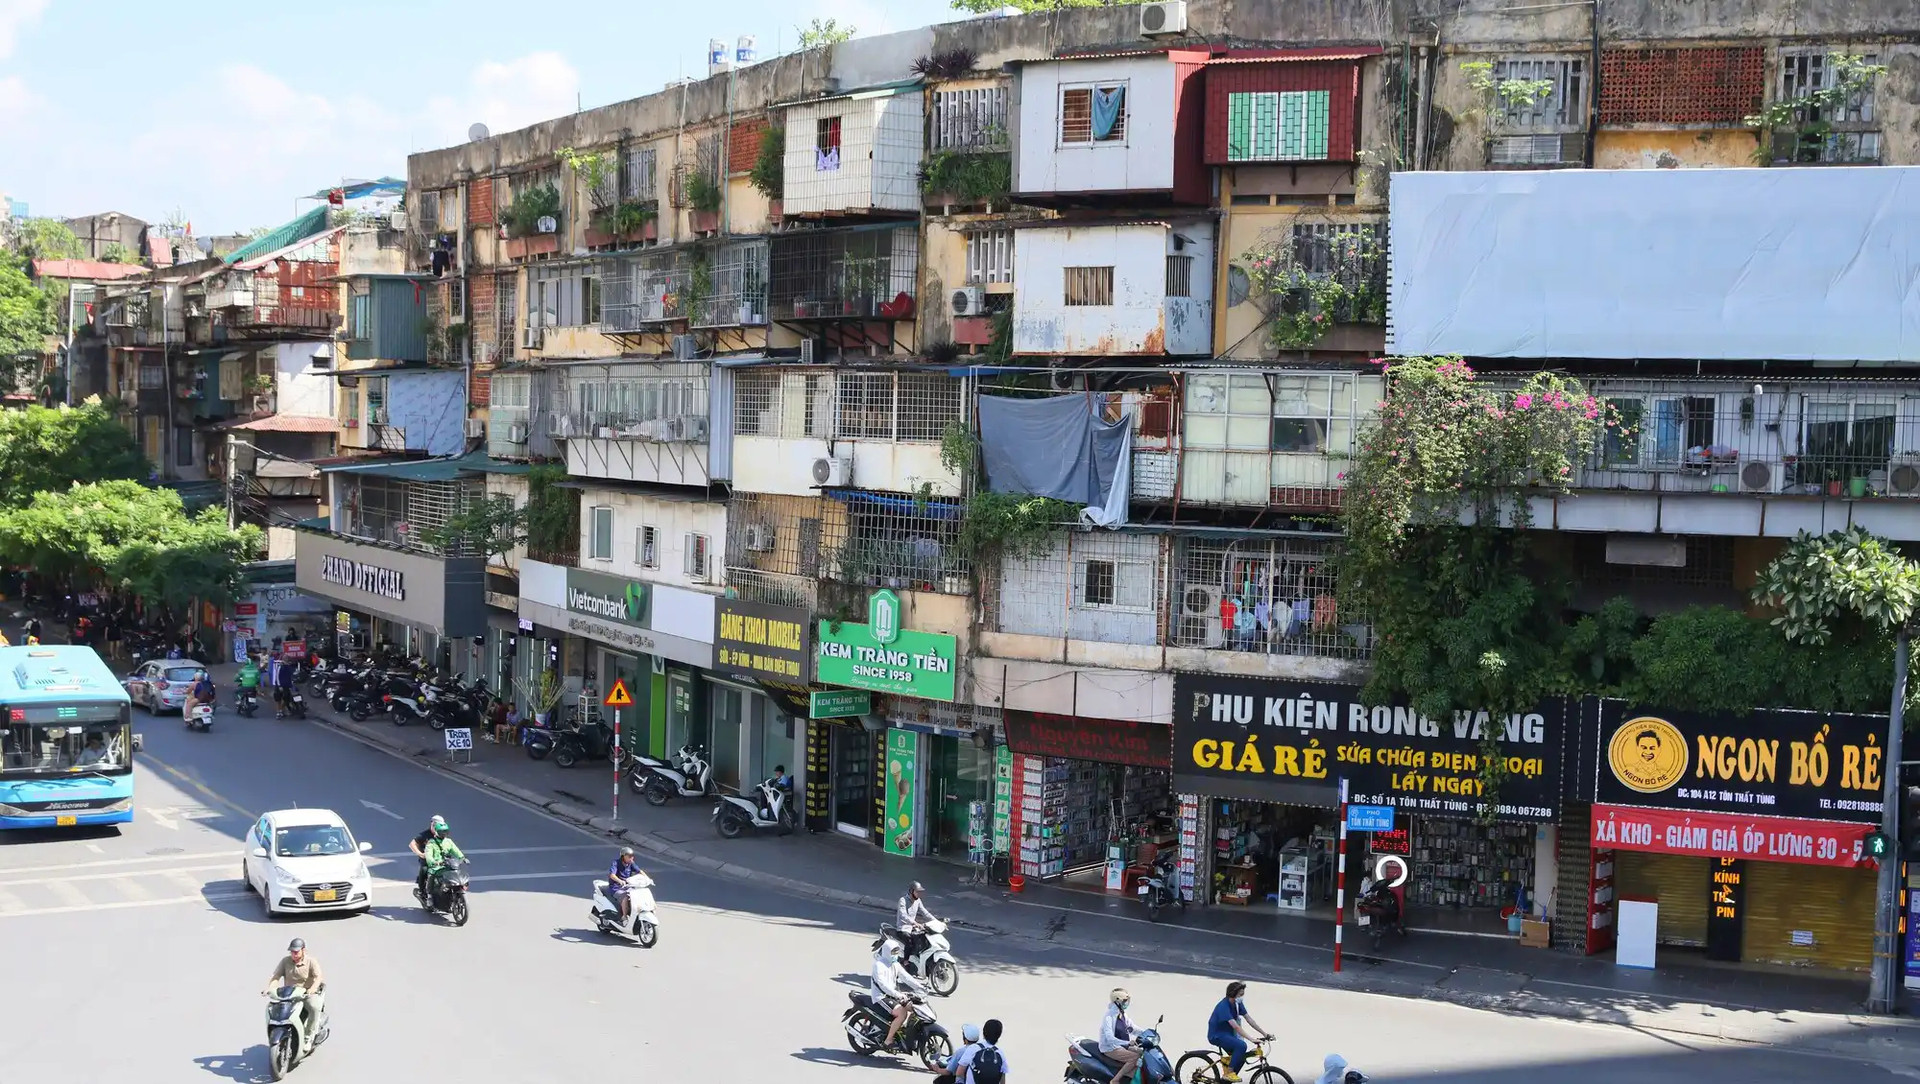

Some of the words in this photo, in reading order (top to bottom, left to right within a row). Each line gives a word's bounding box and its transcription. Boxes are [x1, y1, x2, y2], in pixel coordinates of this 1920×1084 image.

[322, 554, 353, 586] 2HAND
[355, 562, 404, 601] OFFICIAL
[569, 588, 626, 620] Vietcombank
[744, 616, 767, 645] KHOA
[768, 620, 800, 650] MOBILE
[820, 641, 852, 659] KEM
[856, 644, 908, 667] TRÀNG
[913, 647, 949, 673] TIỀN
[853, 665, 886, 678] SINCE
[890, 670, 912, 682] 1958
[817, 698, 830, 706] KEM
[1264, 692, 1338, 735] KIỆN
[448, 739, 461, 748] XE
[462, 739, 470, 747] 10
[1192, 734, 1266, 773] GIÁ
[1272, 738, 1327, 779] RẺ
[1337, 741, 1372, 765] SỬA
[1376, 746, 1425, 768] CHỮA
[1696, 735, 1779, 783] NGON
[1789, 724, 1830, 787] BỔ
[1840, 732, 1881, 790] RẺ
[1392, 770, 1428, 792] LẤY
[1433, 776, 1484, 797] NGAY
[1623, 769, 1644, 784] NGON
[1371, 793, 1384, 804] SỐ
[1386, 797, 1396, 805] 1A
[1399, 796, 1416, 807] TÔN
[1420, 797, 1441, 809] THẤT
[1444, 799, 1468, 811] TÙNG
[1518, 807, 1552, 817] 067286
[1703, 790, 1716, 800] A12
[1719, 790, 1733, 801] TÔN
[1735, 791, 1754, 803] THẤT
[1756, 792, 1775, 804] TÙNG
[1352, 818, 1361, 826] TÔN
[1362, 816, 1374, 826] THẤT
[1596, 812, 1616, 842] XẢ
[1621, 822, 1652, 845] KHO
[1666, 818, 1706, 849] GIẢM
[1712, 824, 1739, 851] GIÁ
[1743, 823, 1764, 854] ỐP
[1770, 831, 1813, 858] LƯNG
[1817, 838, 1837, 860] 30
[1714, 870, 1740, 884] KÍNH
[1716, 906, 1735, 918] PIN
